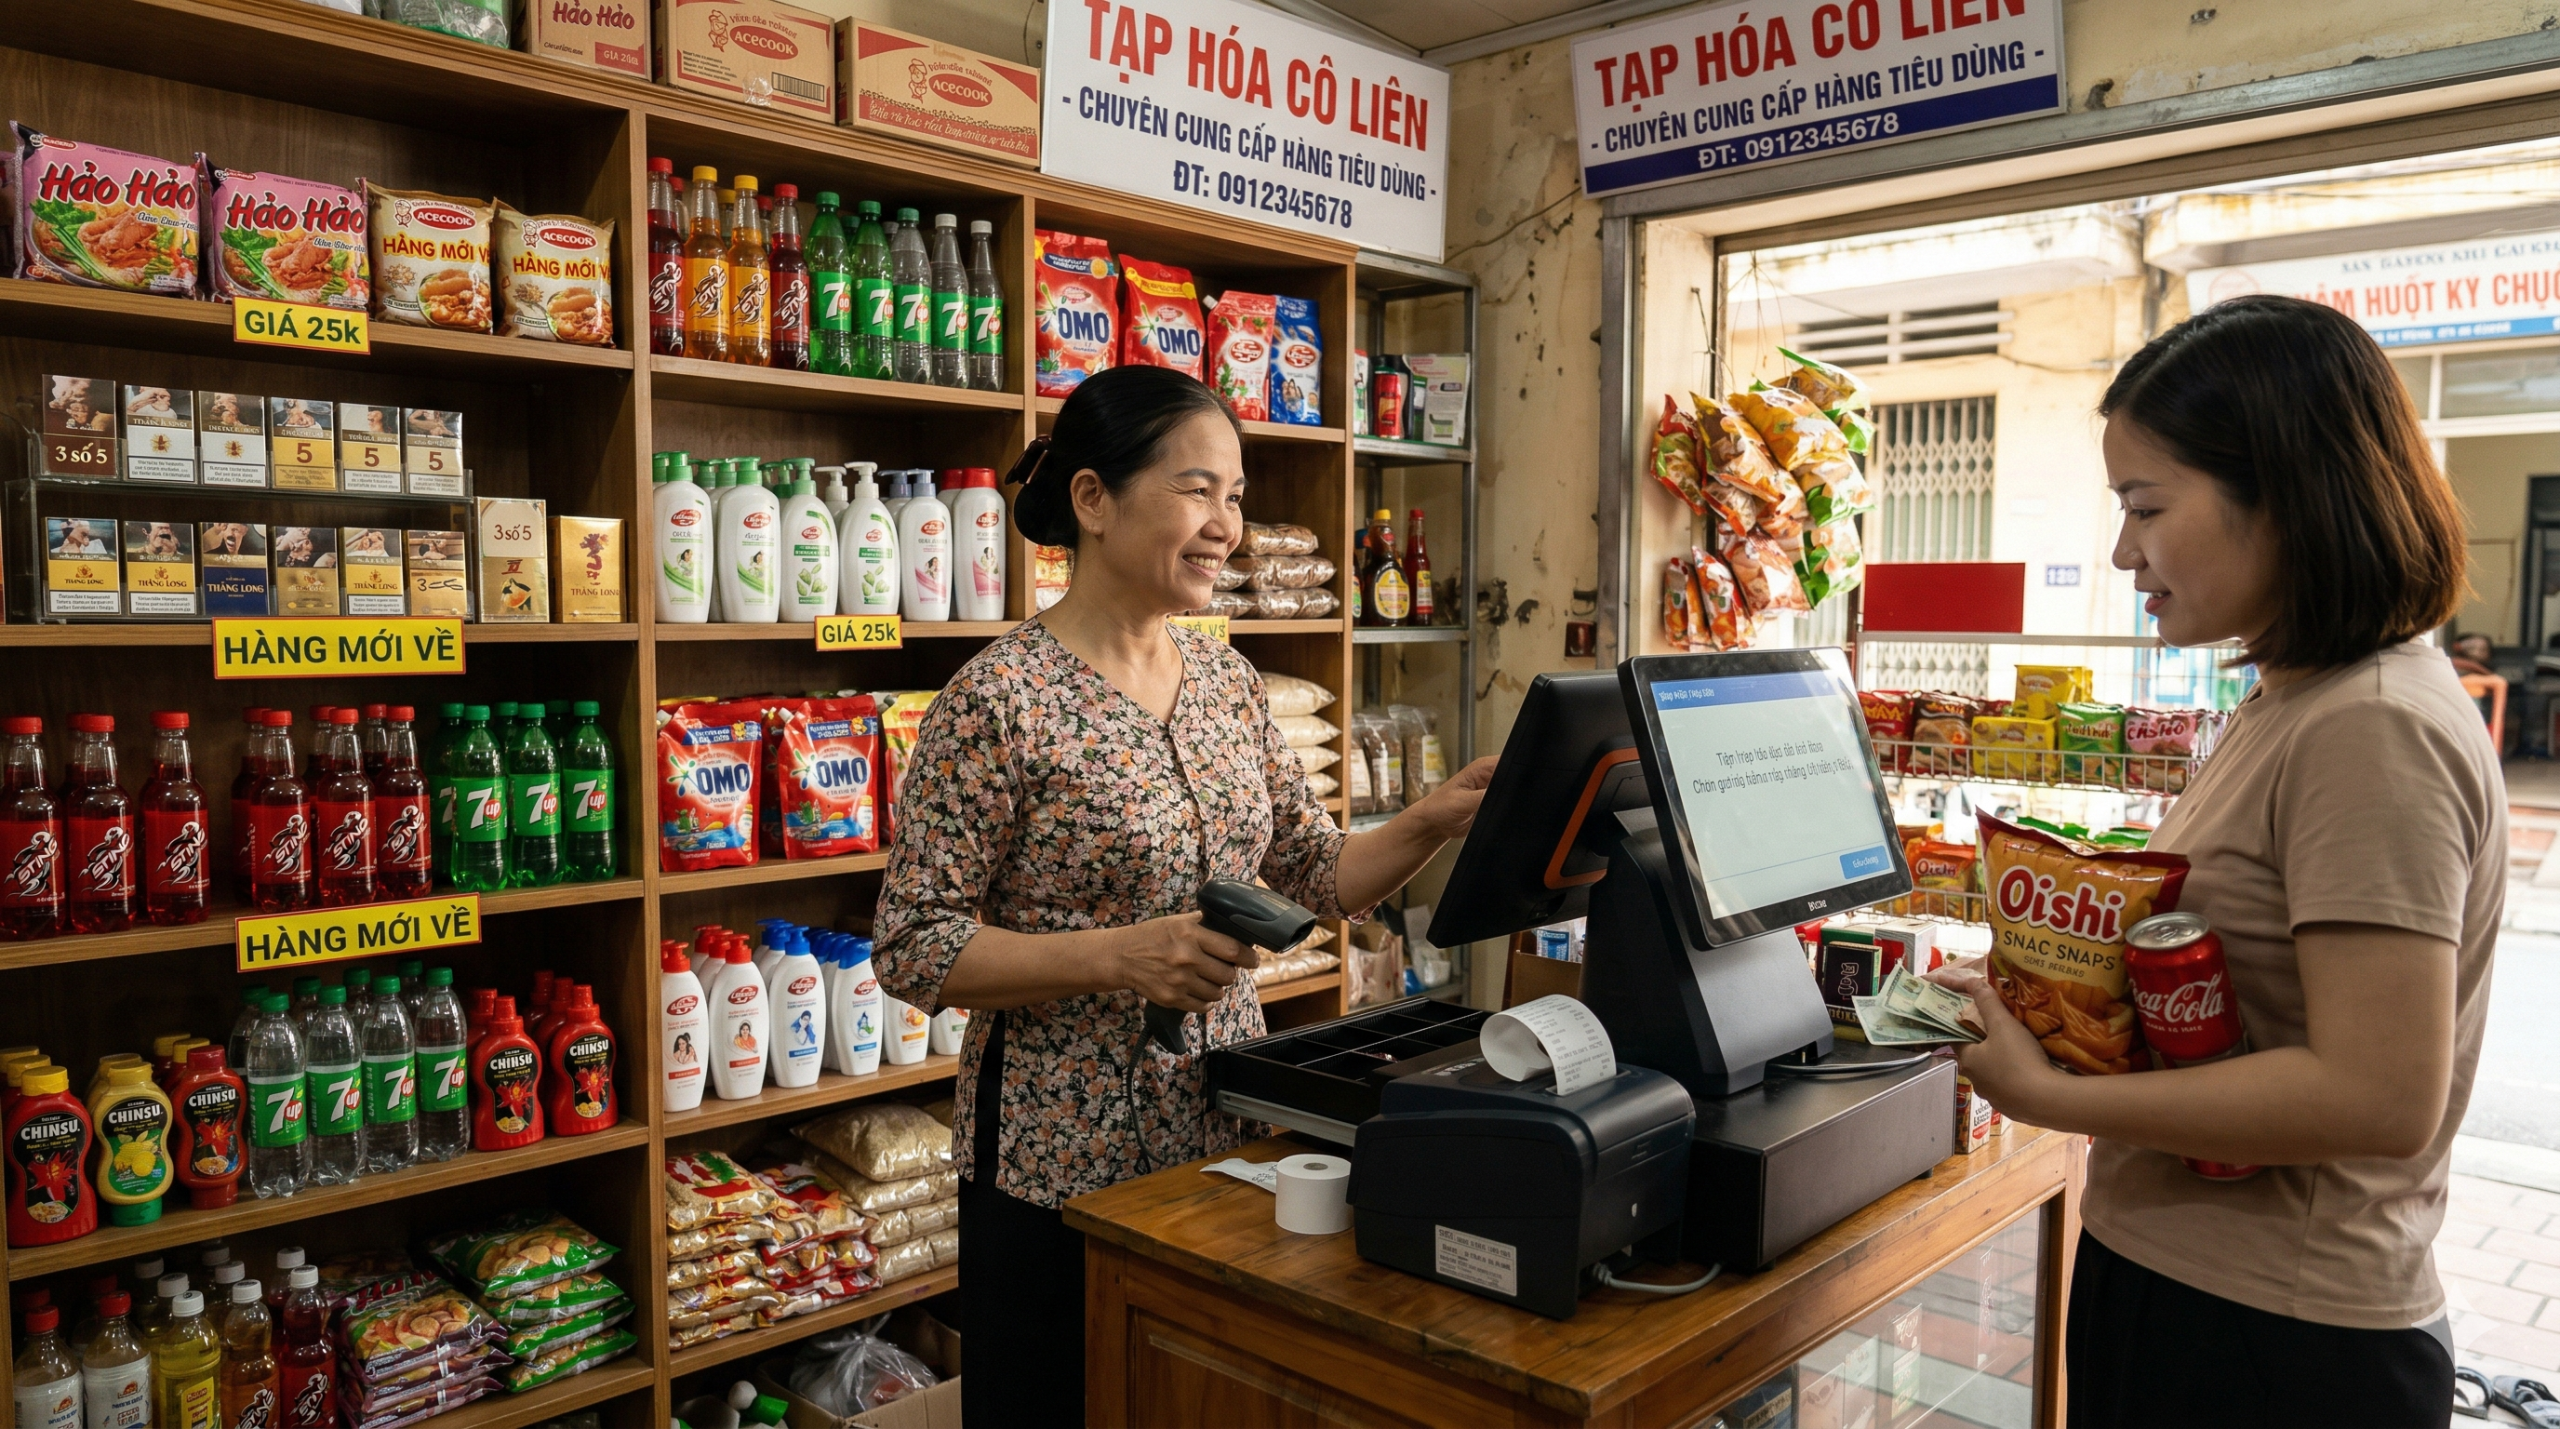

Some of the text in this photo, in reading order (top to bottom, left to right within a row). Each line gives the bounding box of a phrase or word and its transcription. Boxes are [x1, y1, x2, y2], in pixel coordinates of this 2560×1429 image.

[1084, 0, 1429, 152] TẠP HÓA CÔ LIÊN
[1594, 43, 1680, 113] TẠP
[1694, 13, 1797, 87] HÓA
[1604, 111, 1688, 154] CHUYÊN
[1693, 98, 1755, 135] CUNG
[1761, 78, 1807, 121] CẤP
[1814, 72, 1882, 111] HÀNG
[1887, 57, 1944, 94] TIÊU
[1951, 42, 2026, 82] DÙNG
[1079, 86, 1169, 138] CHUYÊN
[1174, 111, 1232, 154] CUNG
[1238, 122, 1277, 164] CẤP
[1282, 137, 1333, 179] HÀNG
[1338, 152, 1376, 189] TIÊU
[1380, 163, 1426, 202] DÙNG
[1698, 112, 1899, 169] ĐT: 0912345678
[39, 161, 197, 211] Hảo Hảo
[1173, 160, 1353, 229] ĐT: 0912345678
[226, 191, 298, 231] Hảo
[302, 196, 366, 234] Hảo
[383, 234, 436, 259] HÀNG
[441, 240, 475, 262] MỚI
[512, 251, 561, 277] HÀNG
[244, 308, 361, 345] GIÁ 25k
[1058, 307, 1110, 344] OMO
[1158, 326, 1201, 357] OMO
[55, 445, 67, 463] 3
[96, 449, 108, 464] 5
[296, 442, 313, 463] 5
[364, 447, 380, 468] 5
[428, 451, 444, 471] 5
[494, 524, 504, 540] 3
[522, 525, 532, 541] 5
[223, 626, 456, 665] HÀNG MỚI VỀ
[822, 619, 897, 645] GIÁ 25k
[695, 763, 750, 796] OMO
[816, 757, 868, 788] OMO
[2000, 868, 2123, 940] Oishi
[246, 904, 472, 962] HÀNG MỚI VỀ
[2004, 930, 2116, 972] SNAC SNAPS
